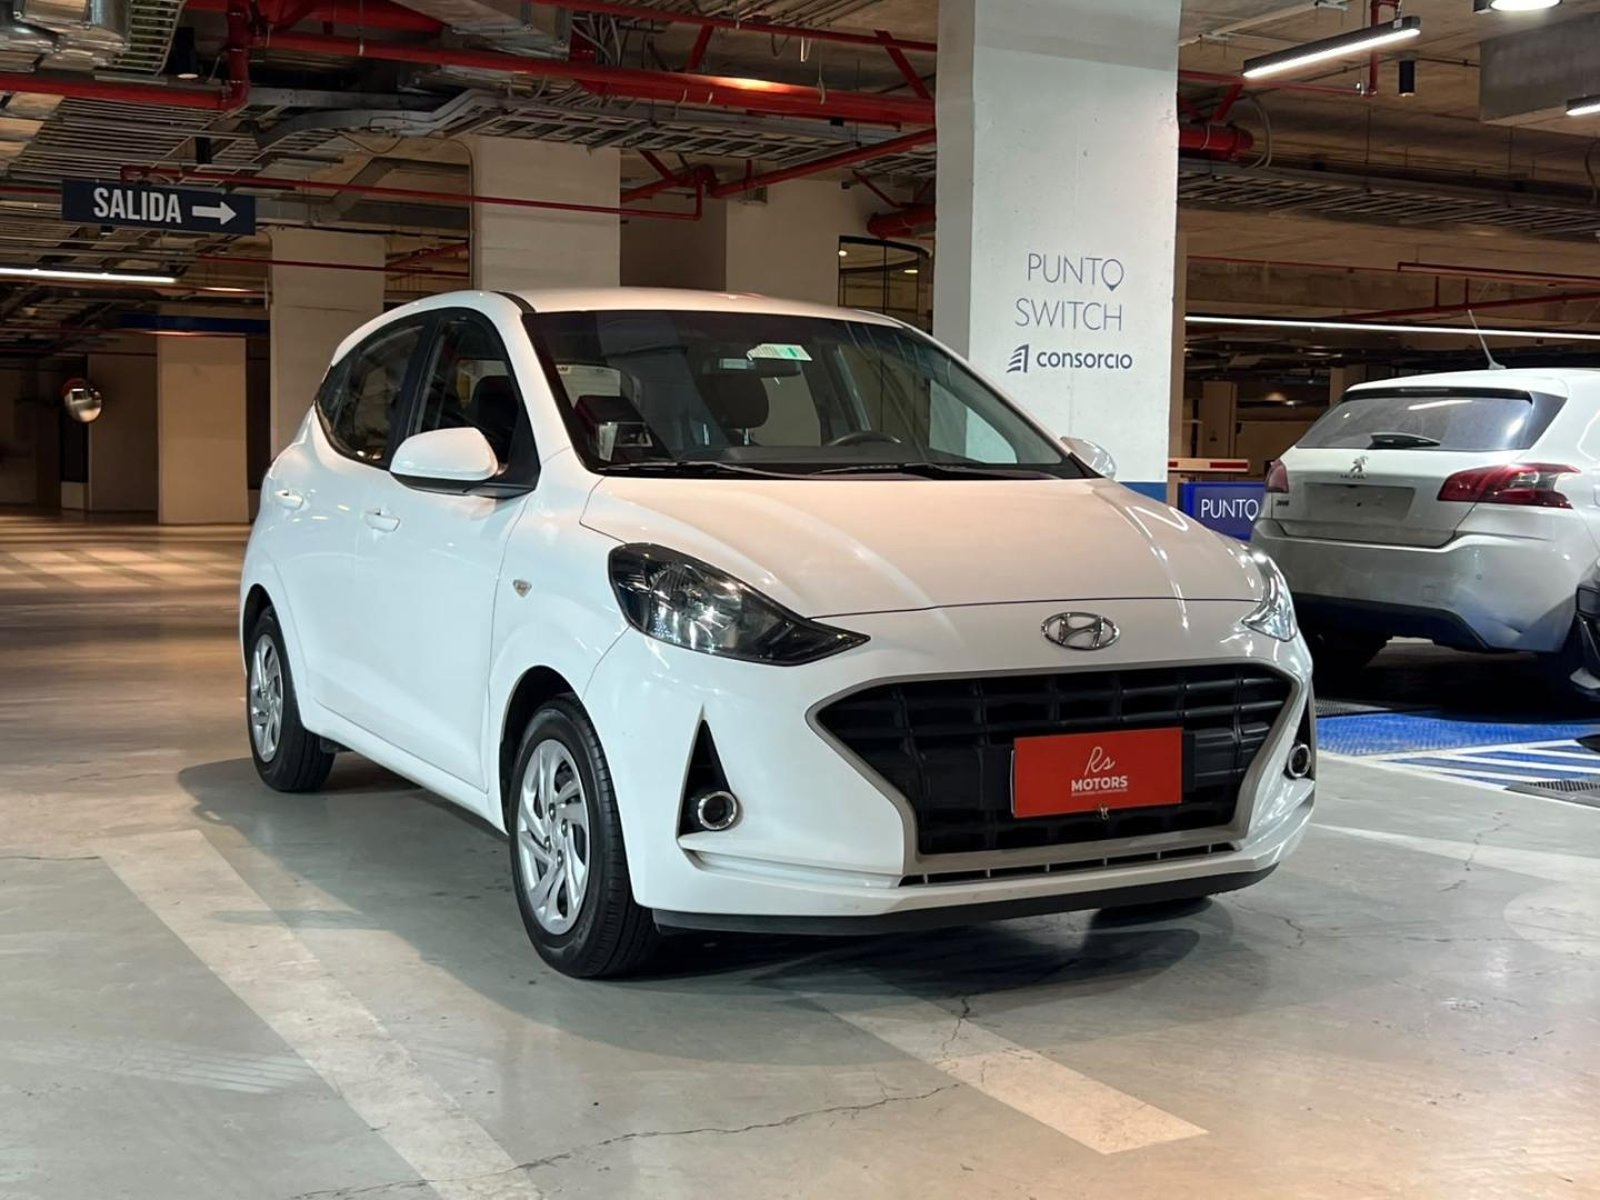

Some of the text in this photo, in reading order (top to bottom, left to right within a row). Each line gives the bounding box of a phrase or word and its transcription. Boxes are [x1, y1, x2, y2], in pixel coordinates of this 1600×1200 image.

[93, 187, 182, 223] SALIDA
[1028, 253, 1124, 291] PUNTO
[1015, 297, 1122, 331] SWITCH
[1037, 351, 1133, 369] consorcio
[1201, 498, 1259, 521] PUNTO
[1084, 746, 1116, 776] Rs
[1071, 776, 1128, 792] MOTORS
